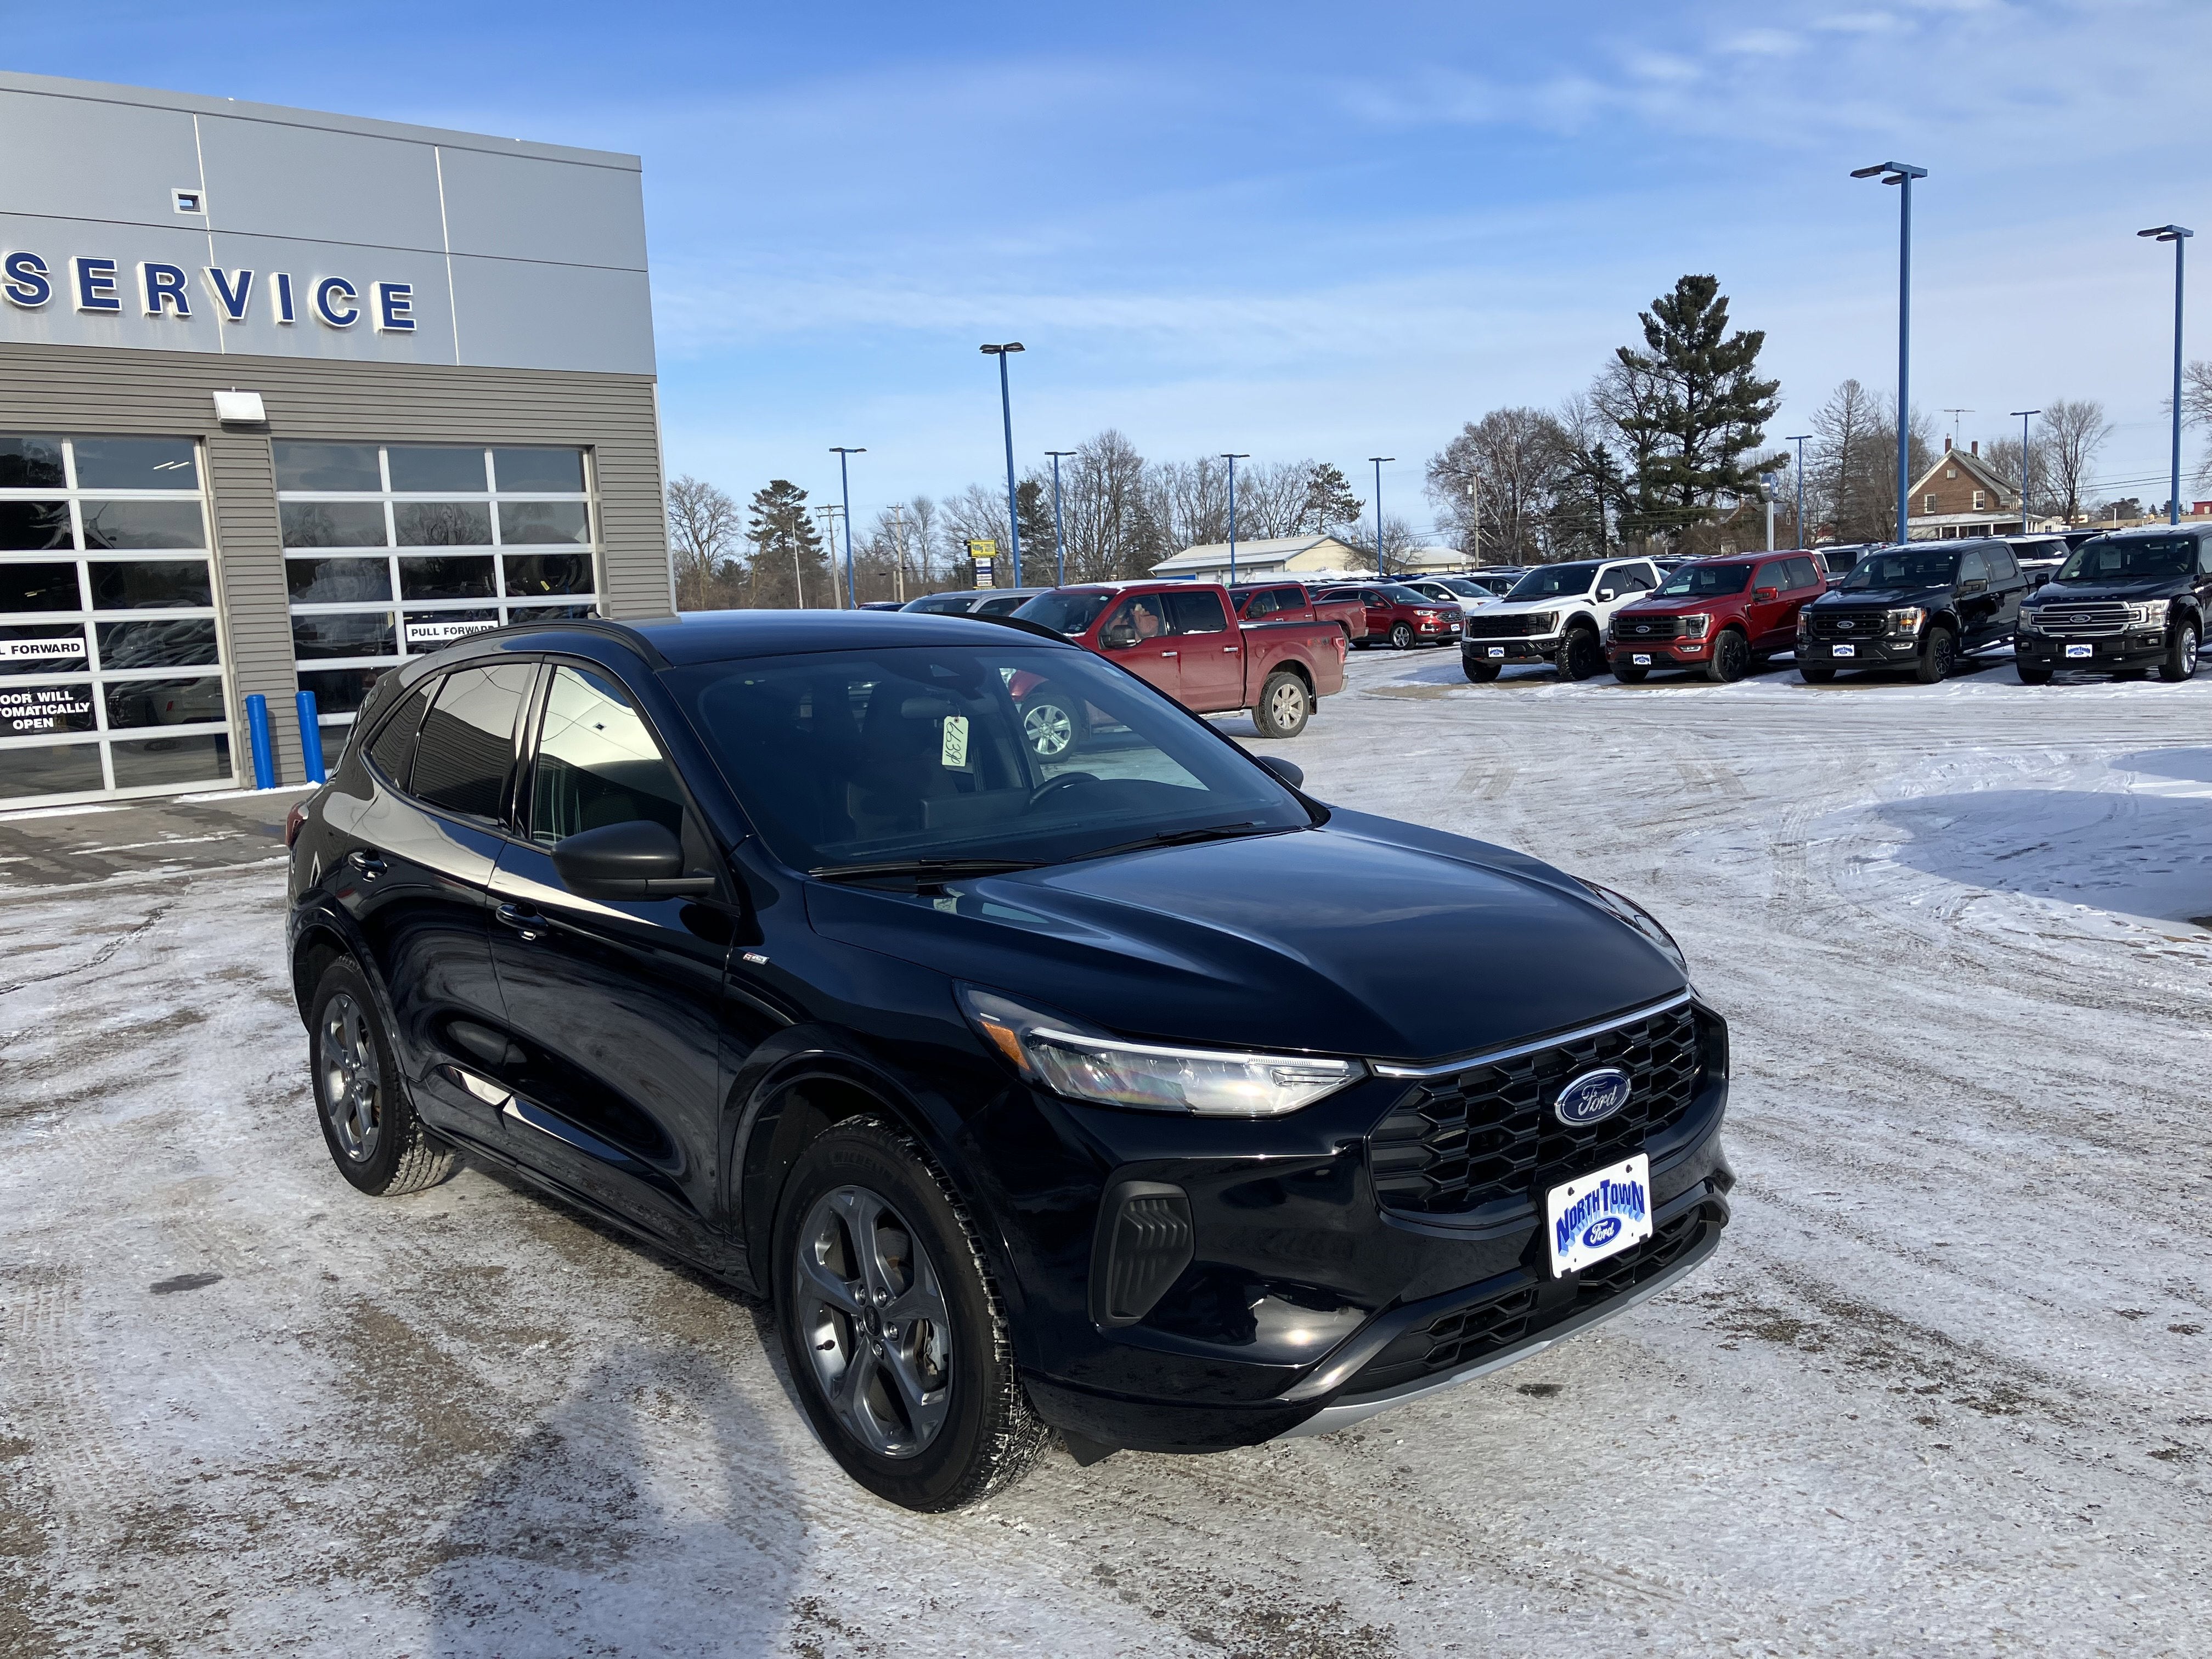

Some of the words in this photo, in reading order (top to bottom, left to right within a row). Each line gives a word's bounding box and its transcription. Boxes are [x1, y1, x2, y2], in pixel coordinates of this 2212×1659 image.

[1, 250, 417, 332] SERVICE
[411, 628, 439, 636] PULL
[11, 643, 80, 654] FORWARD
[37, 691, 74, 702] WILL
[0, 702, 90, 718] OMATICALLY
[13, 718, 54, 730] OPEN
[1578, 1081, 1618, 1116] Ford
[1589, 1221, 1615, 1244] Ford
